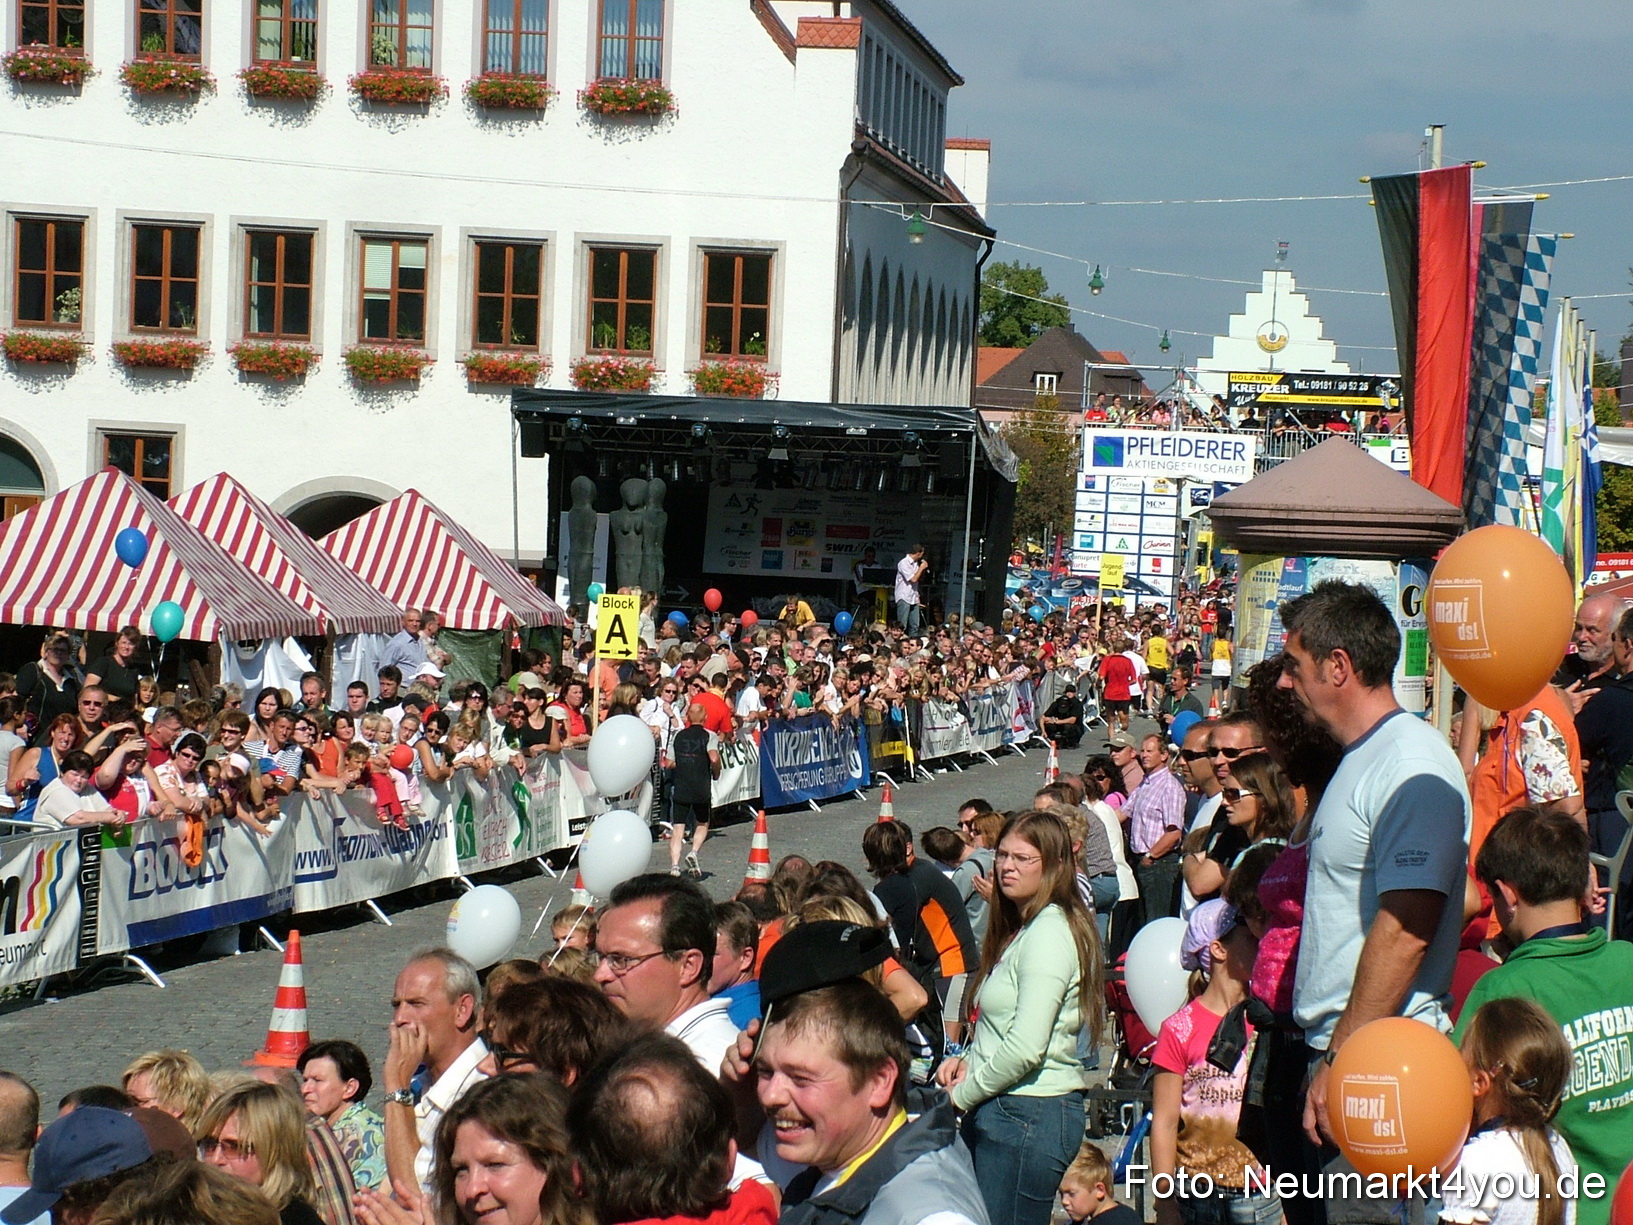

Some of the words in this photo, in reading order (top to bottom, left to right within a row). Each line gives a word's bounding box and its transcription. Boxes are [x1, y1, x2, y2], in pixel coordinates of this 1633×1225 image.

[1230, 383, 1290, 394] KREUZER
[1231, 374, 1274, 382] HOLZBAU
[1310, 380, 1332, 390] 09181
[1338, 381, 1348, 391] 90
[1127, 436, 1246, 462] PFLEIDERER
[602, 597, 634, 609] Block
[1435, 597, 1469, 624] maxi
[605, 614, 629, 645] A
[1458, 622, 1479, 641] dsl
[0, 938, 47, 966] eumarkt
[1562, 1006, 1633, 1050] ALIFORN
[1561, 1035, 1633, 1102] GEND
[1345, 1094, 1386, 1120] maxi
[1373, 1119, 1396, 1137] dsl
